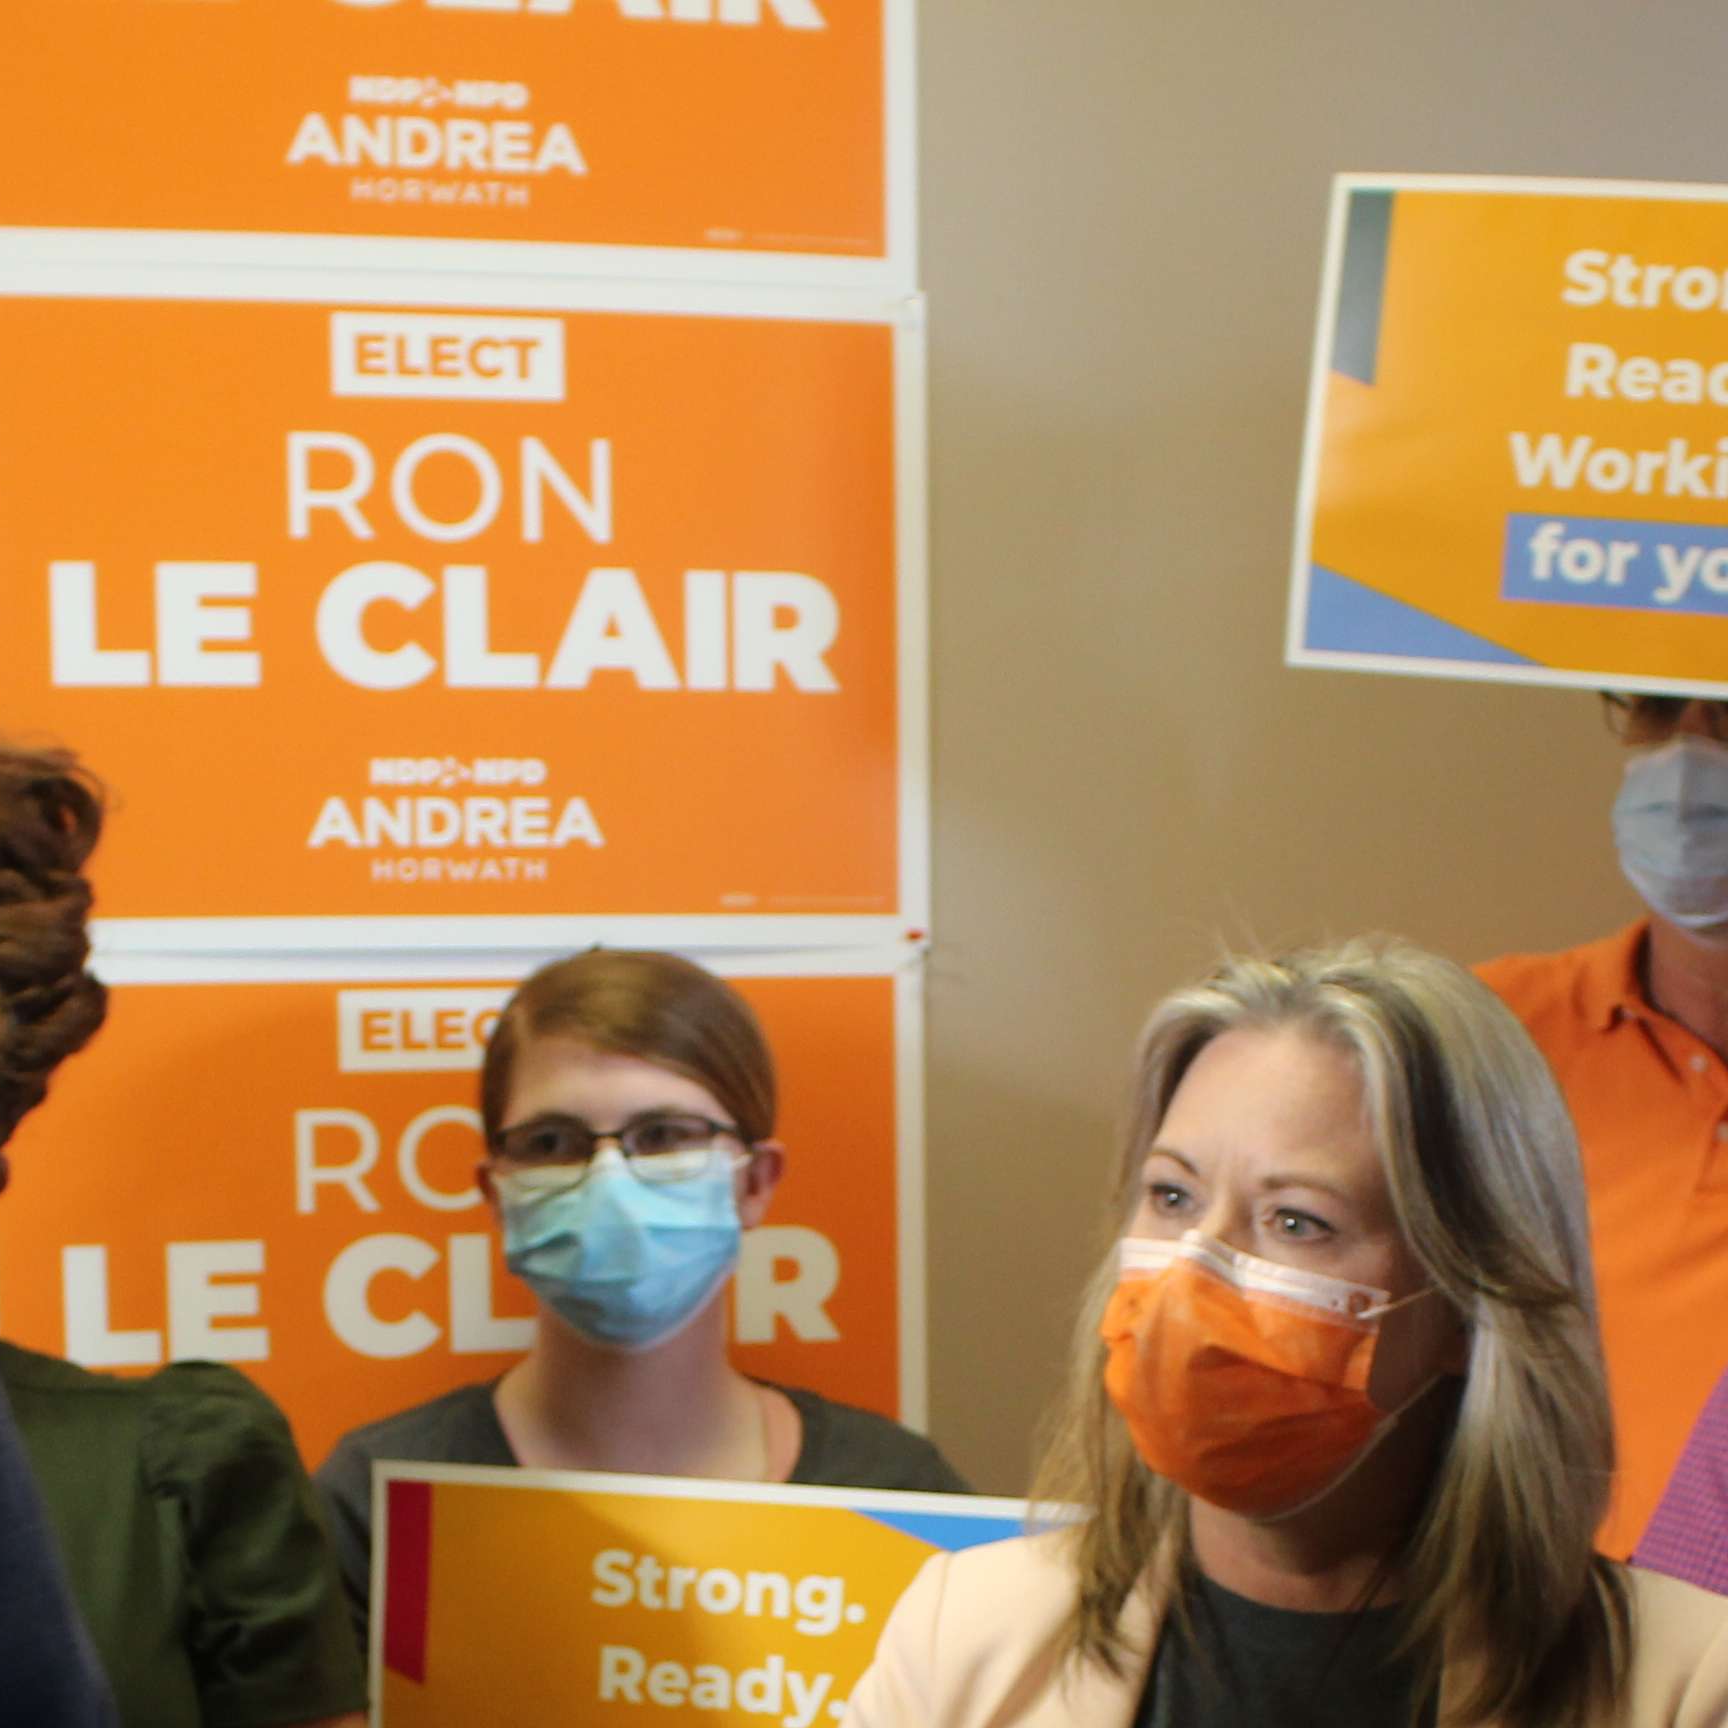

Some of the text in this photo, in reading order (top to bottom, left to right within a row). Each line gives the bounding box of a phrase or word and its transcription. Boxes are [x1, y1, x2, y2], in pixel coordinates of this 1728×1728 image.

[287, 112, 588, 175] ANDREA
[350, 177, 530, 207] HORWATH
[353, 332, 542, 383] ELECT
[287, 430, 613, 544] RON
[1527, 521, 1640, 586] for
[47, 560, 842, 695] LE CLAIR
[307, 796, 606, 848] ANDREA
[370, 857, 549, 883] HORWATH
[293, 1104, 488, 1213] RO
[60, 1225, 841, 1367] LE CLR
[591, 1548, 867, 1639] Strong.
